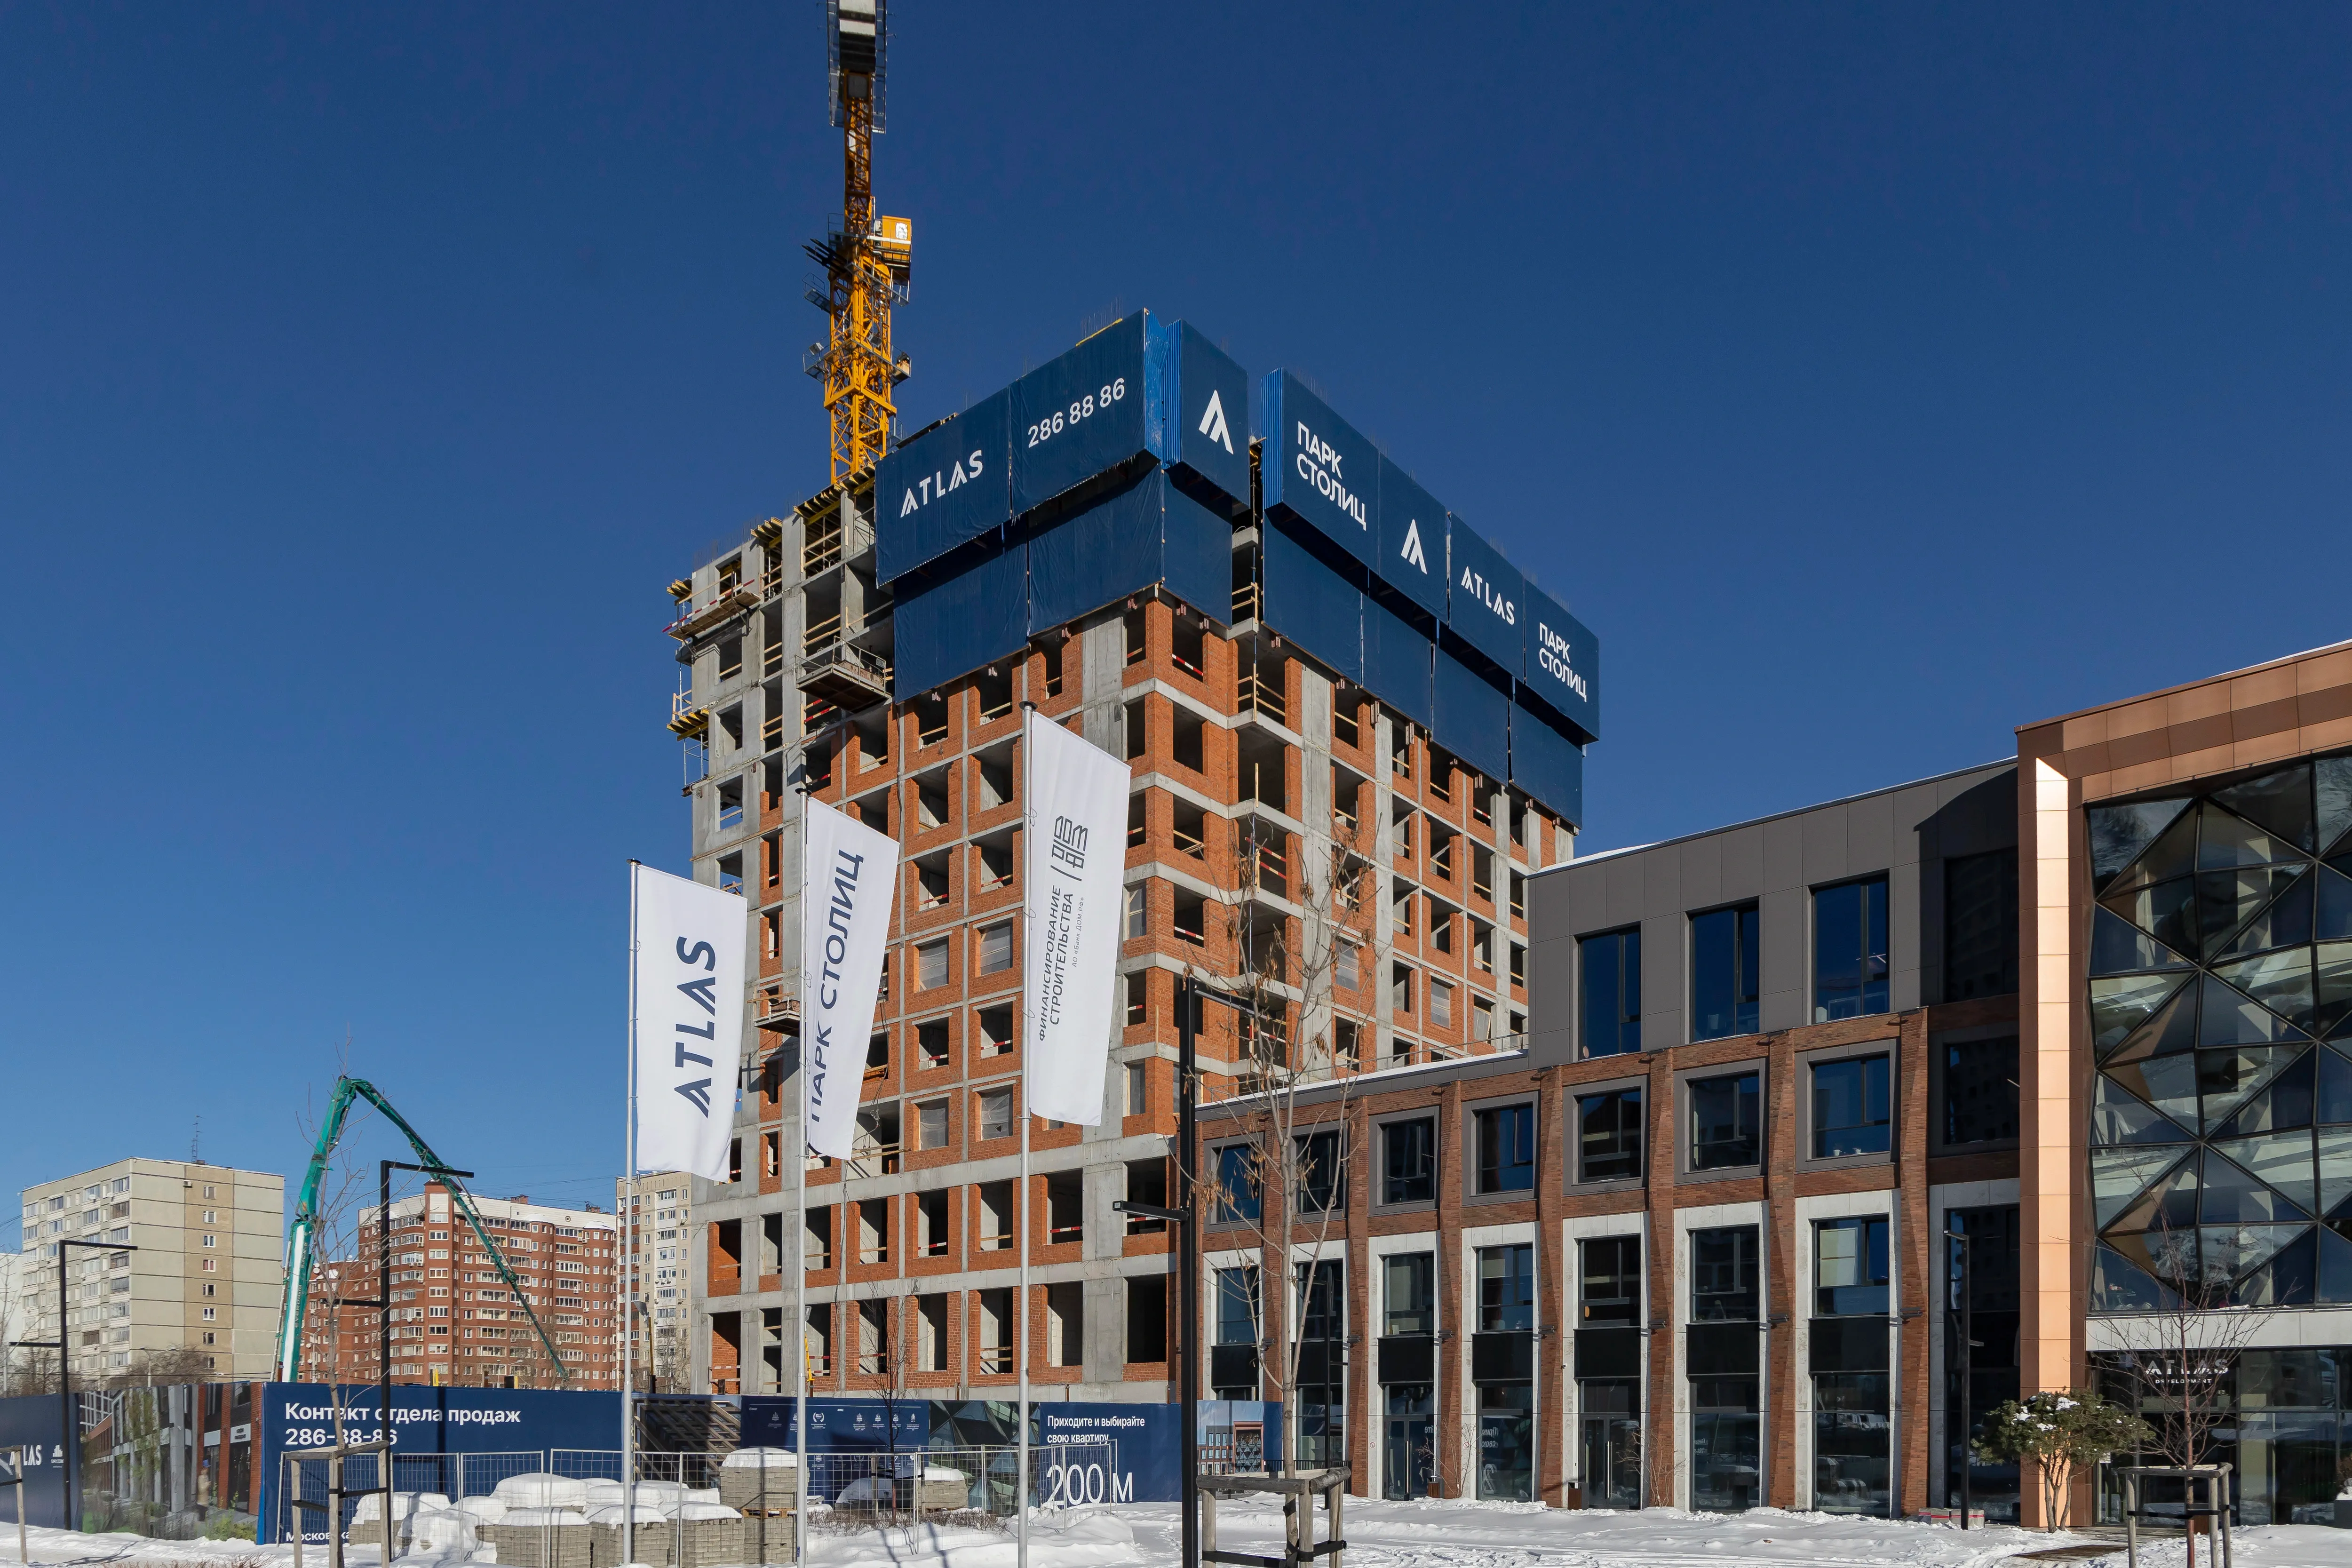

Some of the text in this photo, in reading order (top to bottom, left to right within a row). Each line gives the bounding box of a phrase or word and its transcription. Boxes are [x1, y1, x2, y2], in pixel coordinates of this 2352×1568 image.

[1028, 378, 1125, 448] 286 88 86
[1298, 421, 1342, 479] ПАРК
[900, 450, 983, 518] ATLAS
[1297, 454, 1366, 531] СТОЛИЦ
[1461, 566, 1514, 625] ATLAS
[1540, 622, 1570, 663] ПАРК
[1539, 648, 1587, 702] СТОЛИЦ
[811, 849, 864, 1122] ПАРК СТОЛИЦ
[1039, 885, 1060, 1041] ФИНАНСИРОВАНИЕ
[1050, 893, 1073, 1025] СТРОИТЕЛЬСТВА
[1072, 957, 1078, 967] АО
[675, 936, 715, 1118] ATLAS
[2145, 1359, 2228, 1375] ATLAS
[286, 1403, 521, 1425] Контакт отдела продаж
[1047, 1434, 1109, 1445] свою квартиру
[1048, 1416, 1093, 1429] Приходите
[1101, 1416, 1145, 1429] выбирайте
[9, 1445, 42, 1465] ALAS
[1047, 1464, 1104, 1505] 200
